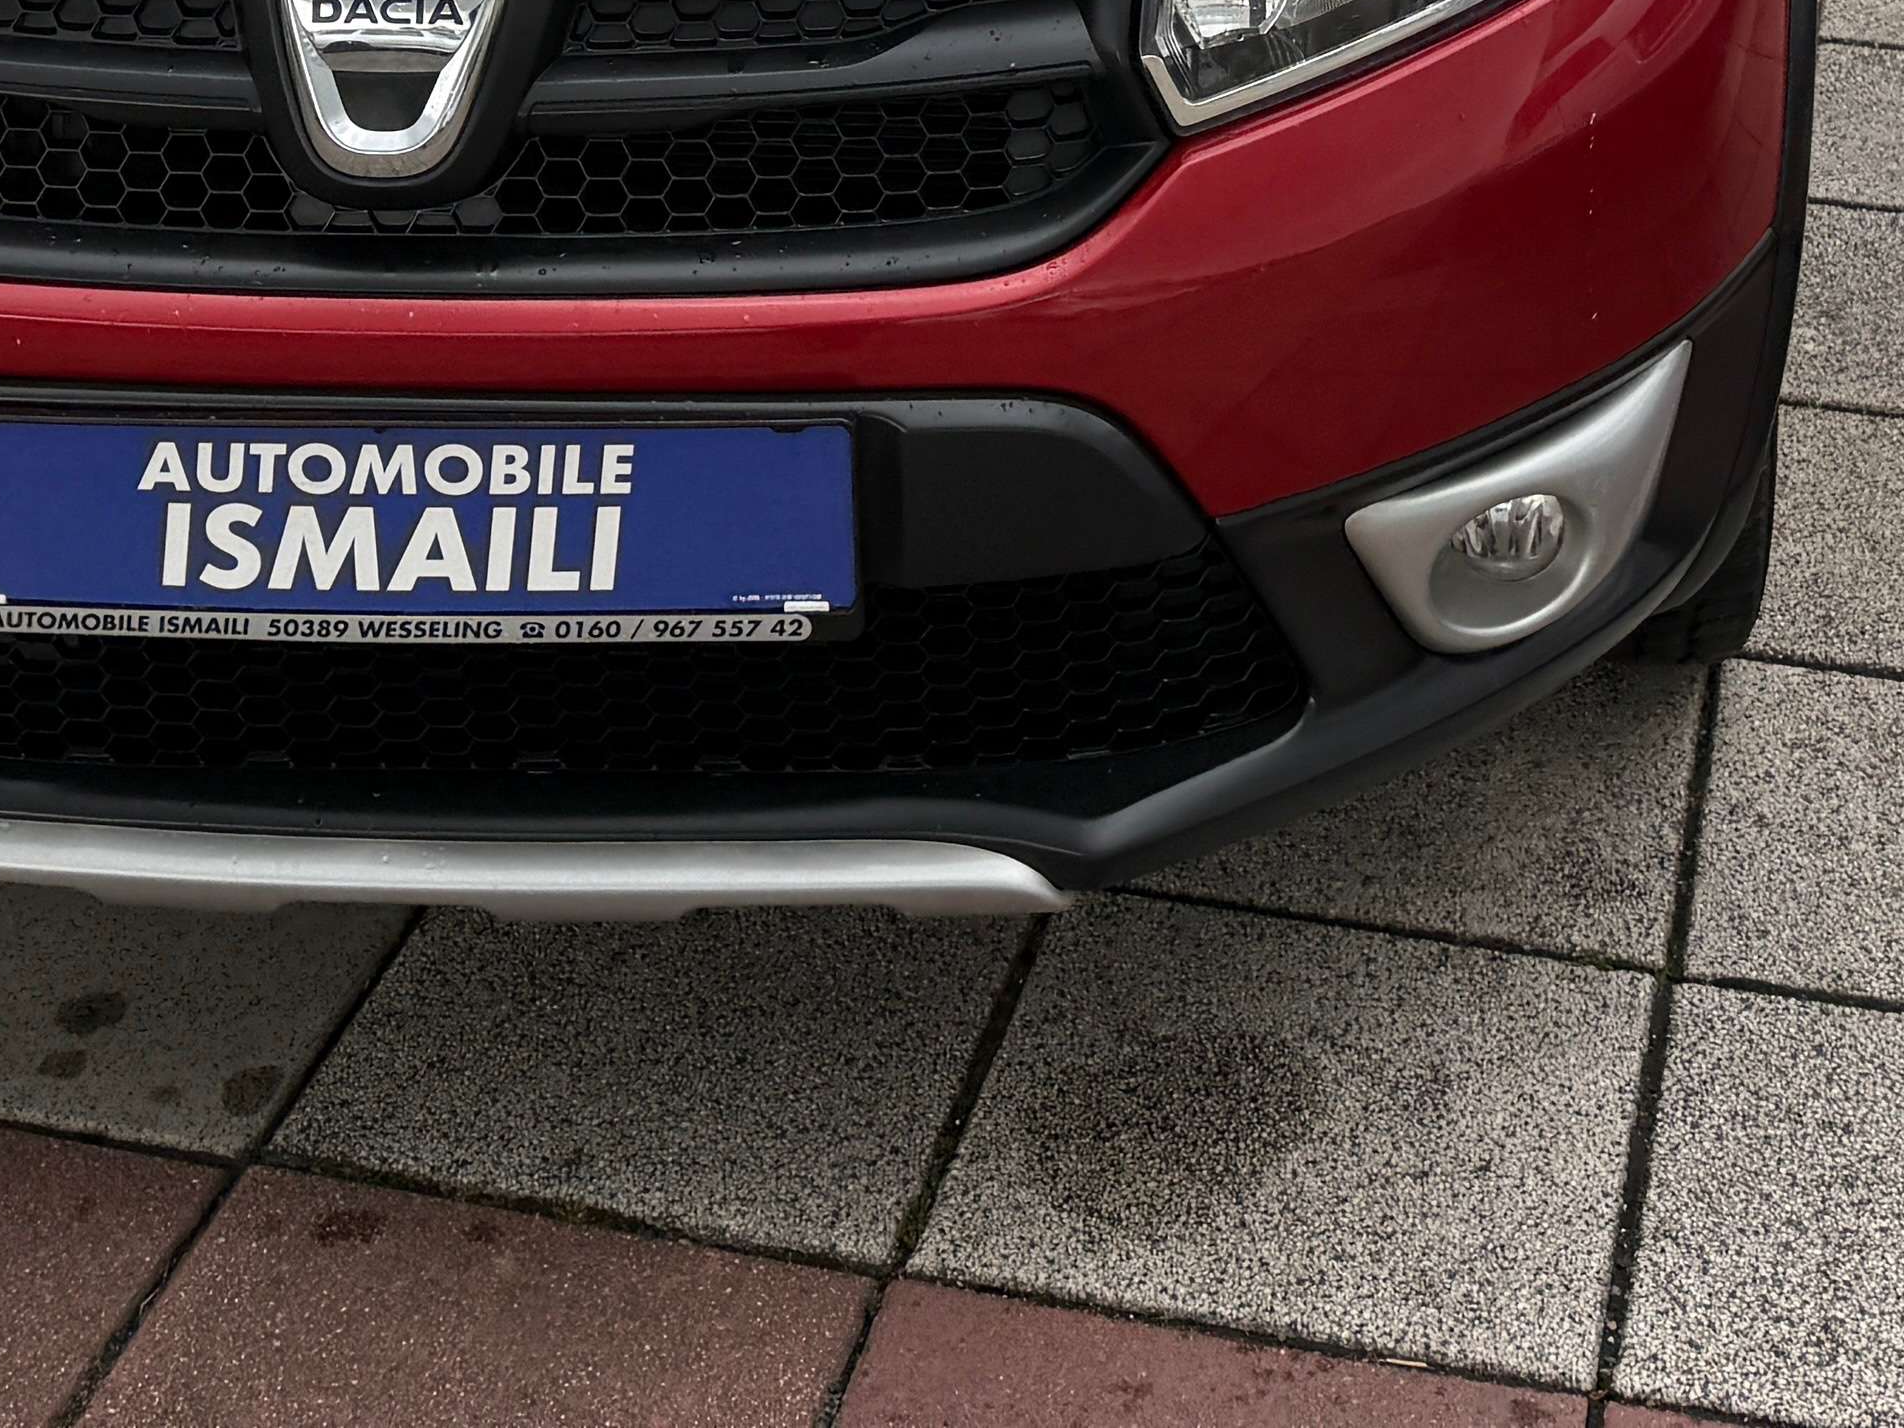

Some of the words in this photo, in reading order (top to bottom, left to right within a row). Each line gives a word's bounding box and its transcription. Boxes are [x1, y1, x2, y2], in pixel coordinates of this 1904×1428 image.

[136, 441, 634, 497] AUTOMOBILE
[161, 502, 622, 593] ISMAILI
[159, 614, 249, 636] ISMAILI
[267, 618, 349, 639] 50389
[358, 619, 503, 640] WESSELING
[555, 619, 622, 639] 0160
[630, 618, 642, 640] /
[653, 619, 701, 639] 967
[711, 619, 762, 638] 557
[770, 619, 804, 637] 42
